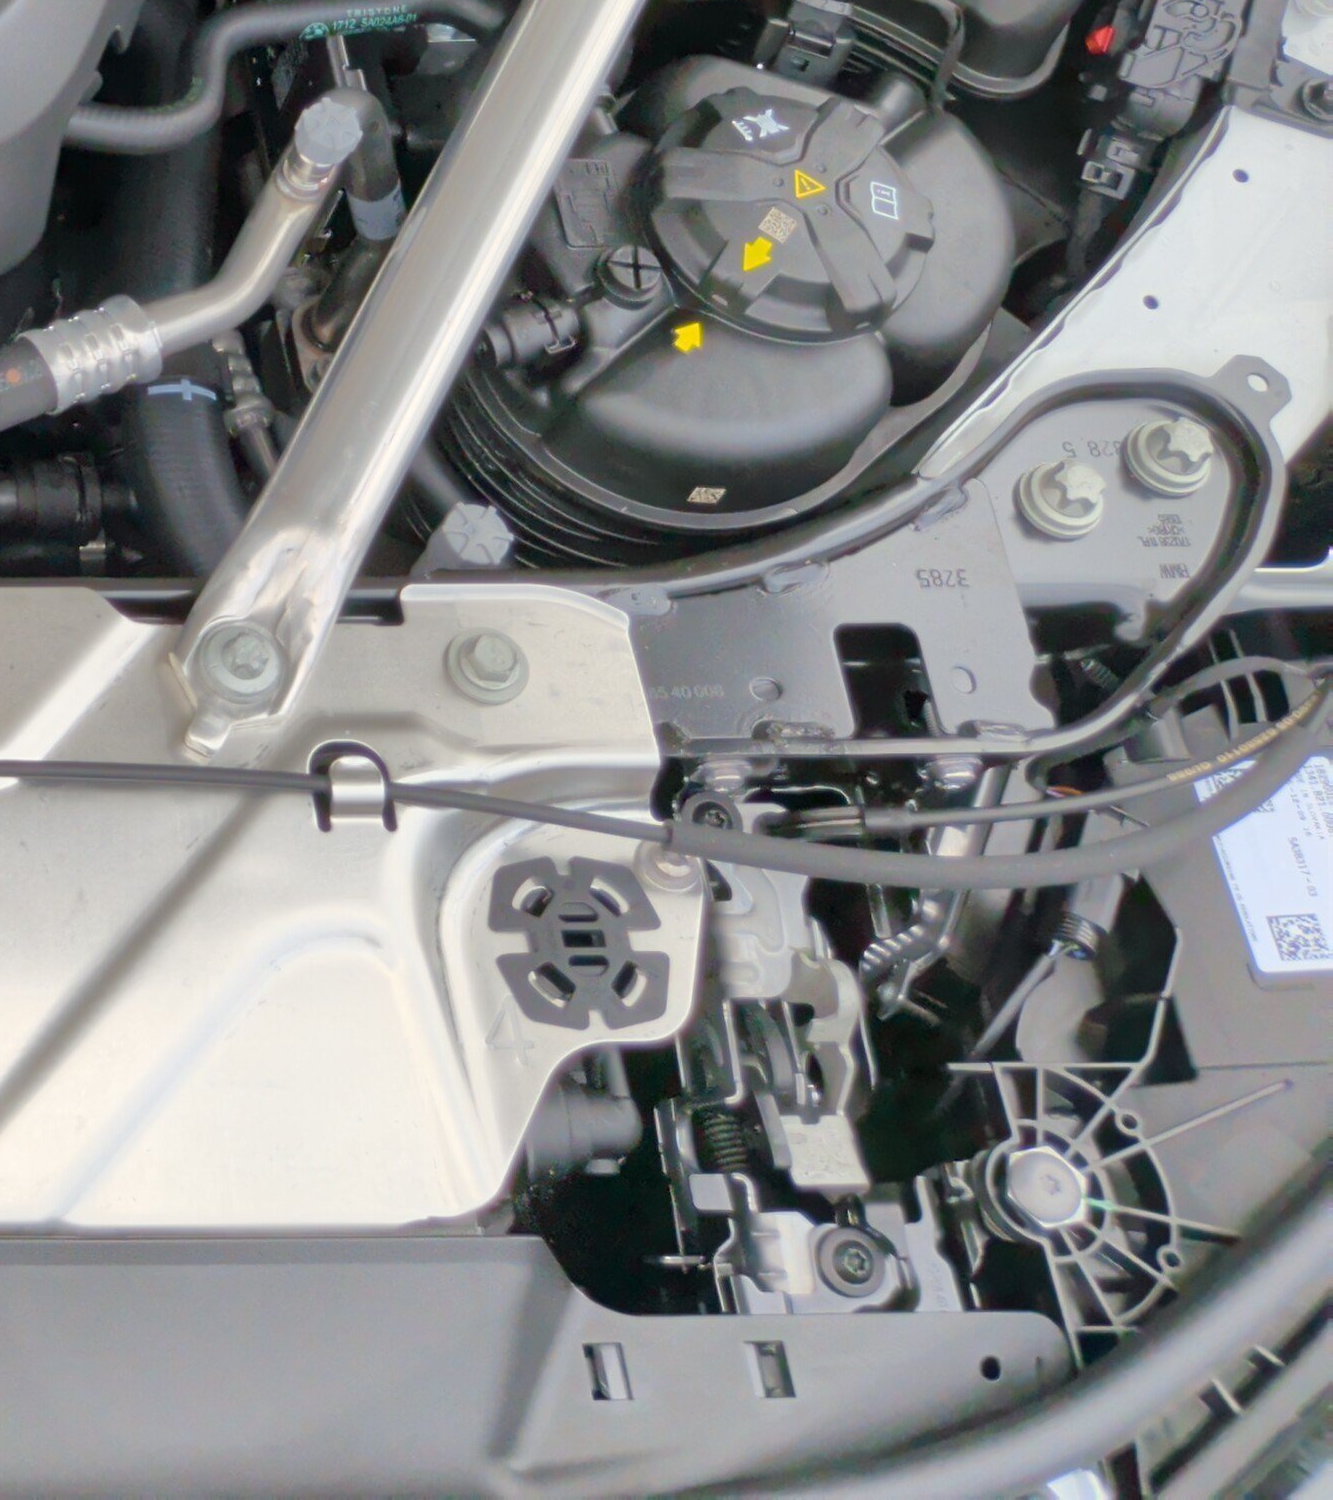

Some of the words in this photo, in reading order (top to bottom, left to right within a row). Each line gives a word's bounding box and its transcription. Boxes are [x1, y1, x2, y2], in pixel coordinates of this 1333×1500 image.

[346, 4, 408, 17] TRISTONE
[917, 567, 971, 588] 3285
[1158, 563, 1190, 579] BMW
